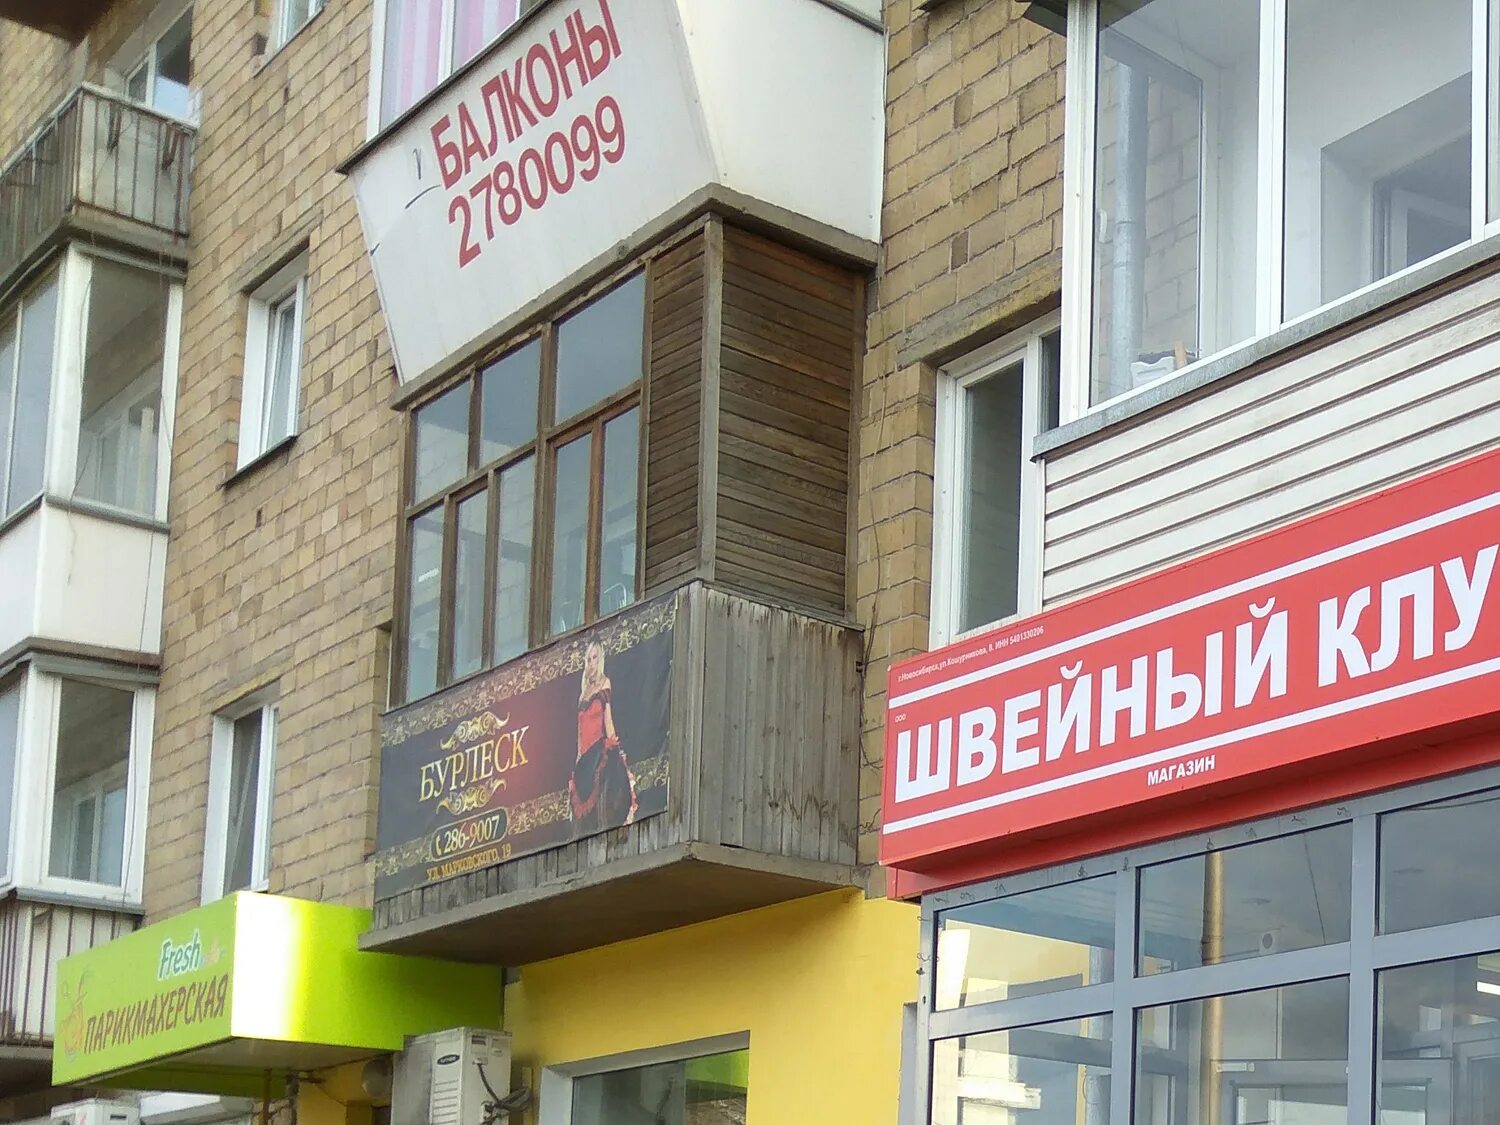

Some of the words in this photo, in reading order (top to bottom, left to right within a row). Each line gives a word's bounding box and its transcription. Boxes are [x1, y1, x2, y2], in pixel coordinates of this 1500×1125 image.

[430, 0, 622, 190] БАЛКОНЫ
[448, 95, 626, 268] 2780099
[894, 597, 1288, 803] ШВЕЙНЫЙ
[419, 726, 529, 802] БУРЛЕСК
[1147, 755, 1216, 786] МАГАЗИН
[158, 929, 201, 981] Fresh
[84, 973, 229, 1054] ПАРИКМАХЕРСКАЯ
